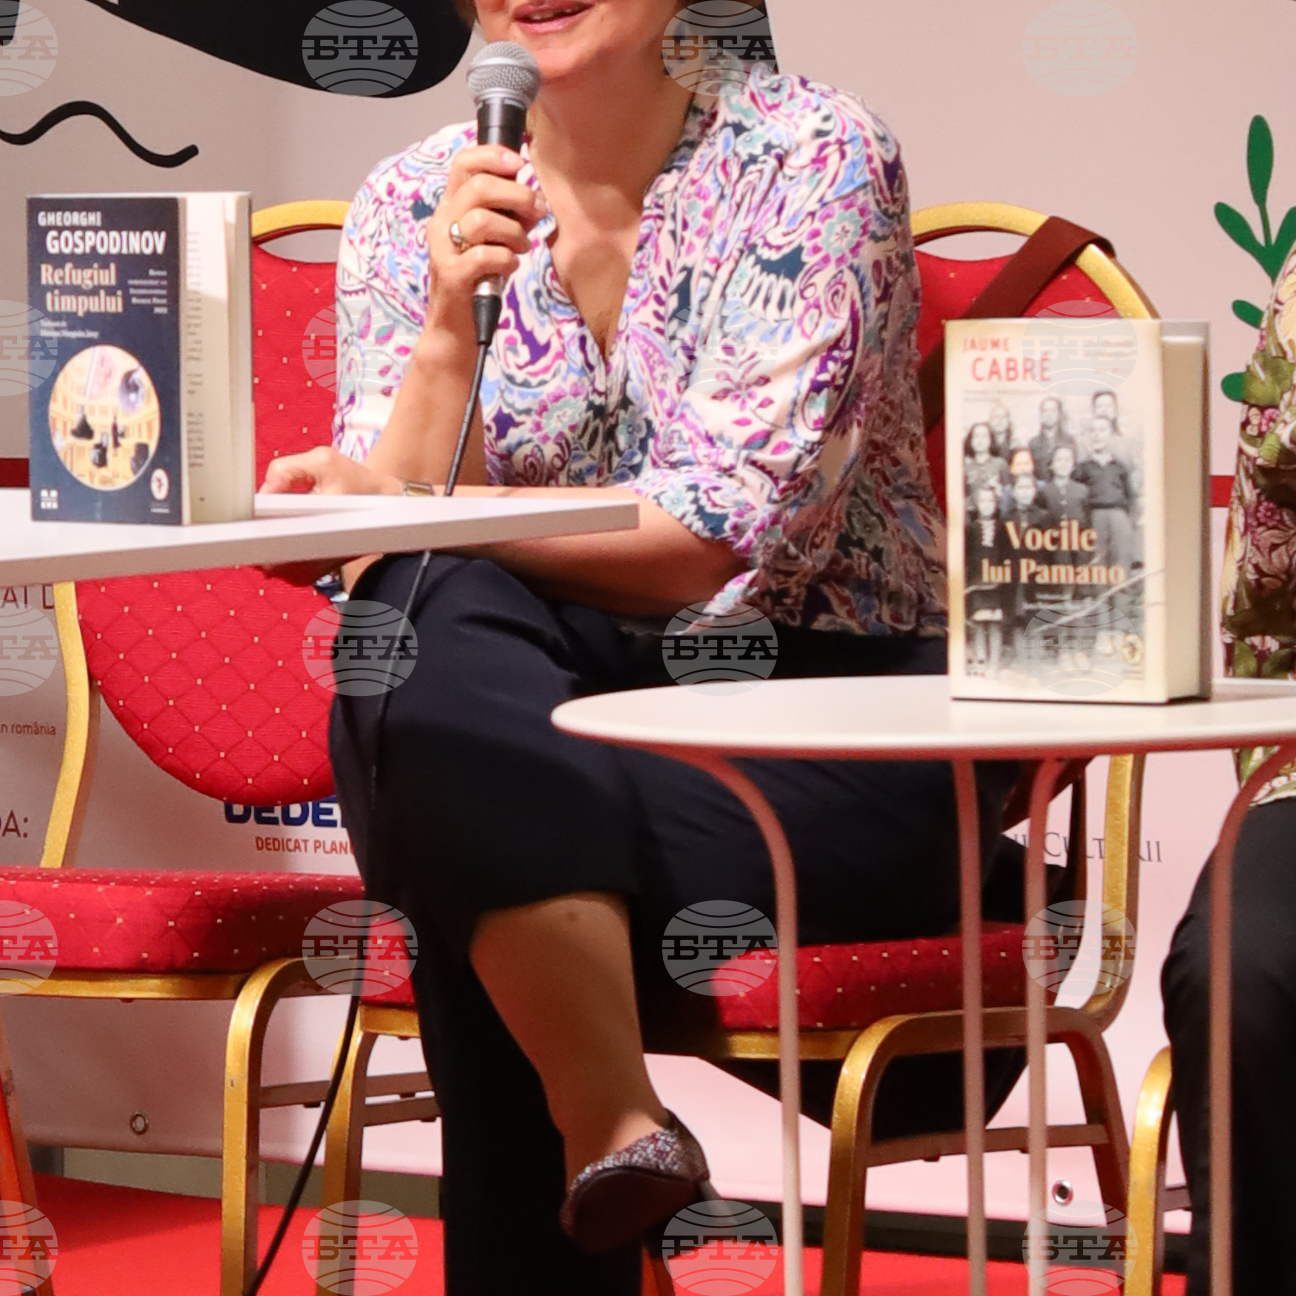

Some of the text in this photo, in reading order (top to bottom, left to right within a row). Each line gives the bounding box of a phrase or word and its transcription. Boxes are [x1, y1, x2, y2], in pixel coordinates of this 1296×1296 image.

[37, 210, 102, 227] GHEORGHI
[46, 230, 167, 255] GOSPODINOV
[40, 262, 117, 290] Refugiul
[46, 289, 123, 317] timpului
[962, 337, 1010, 352] JAUME
[971, 350, 1052, 382] CABRÉ
[1006, 519, 1098, 551] Vocile
[981, 558, 1012, 583] lui
[11, 720, 56, 736] românia
[255, 837, 310, 853] DEDICAT
